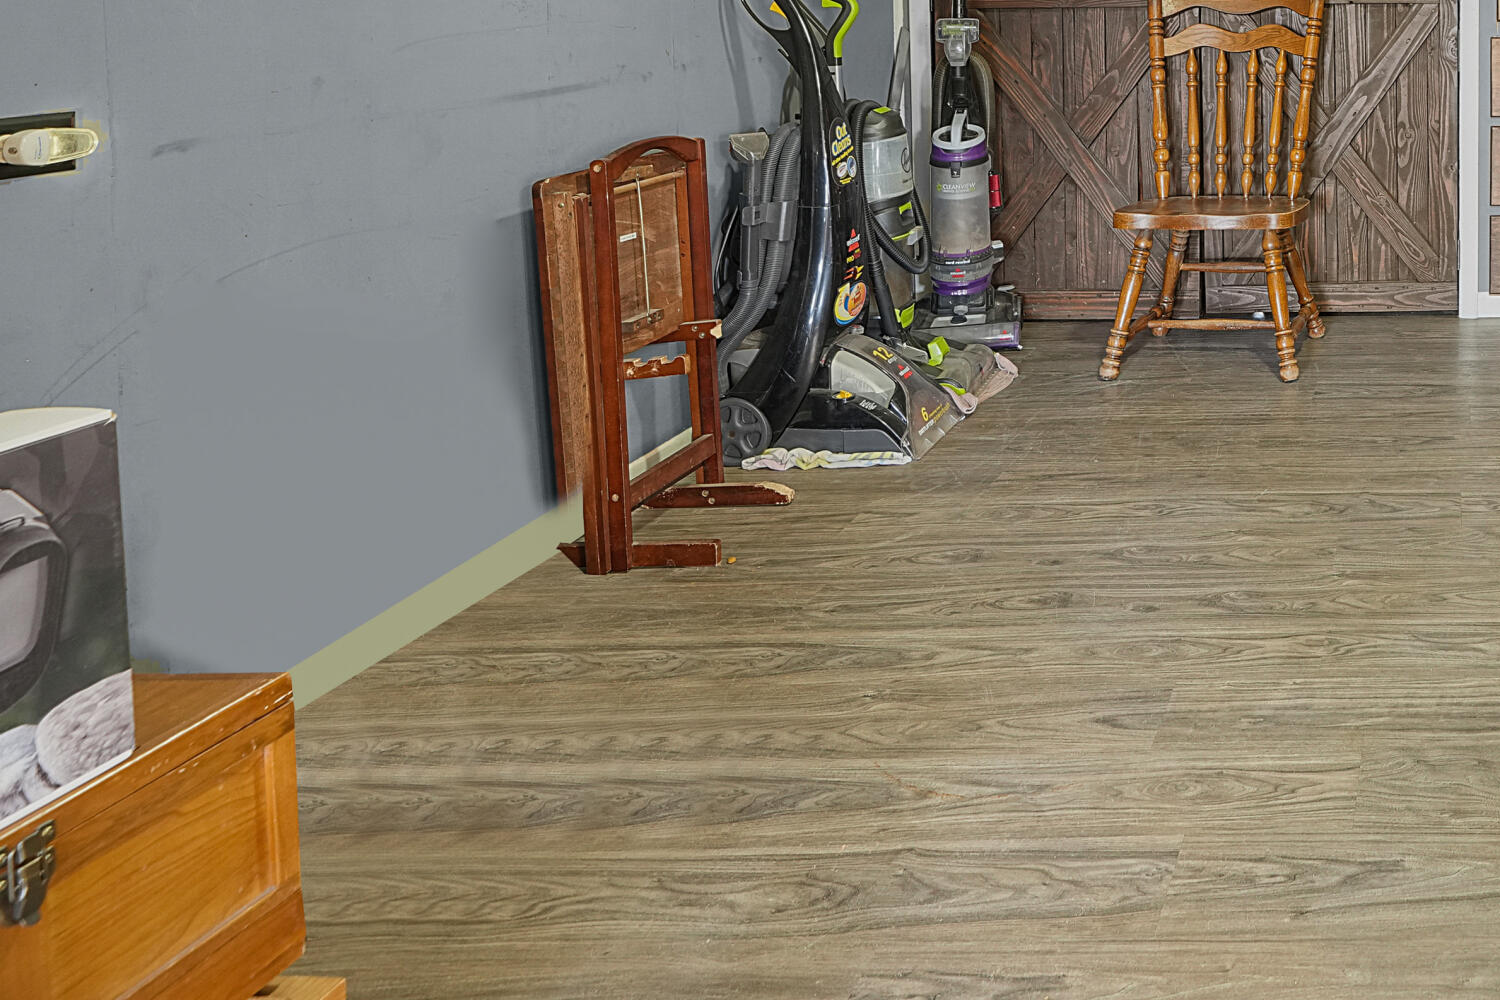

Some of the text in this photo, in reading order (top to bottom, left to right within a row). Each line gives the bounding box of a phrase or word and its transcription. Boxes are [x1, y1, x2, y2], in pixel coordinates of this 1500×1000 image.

[836, 122, 848, 139] Out
[872, 346, 893, 361] 12
[921, 407, 929, 422] 6
